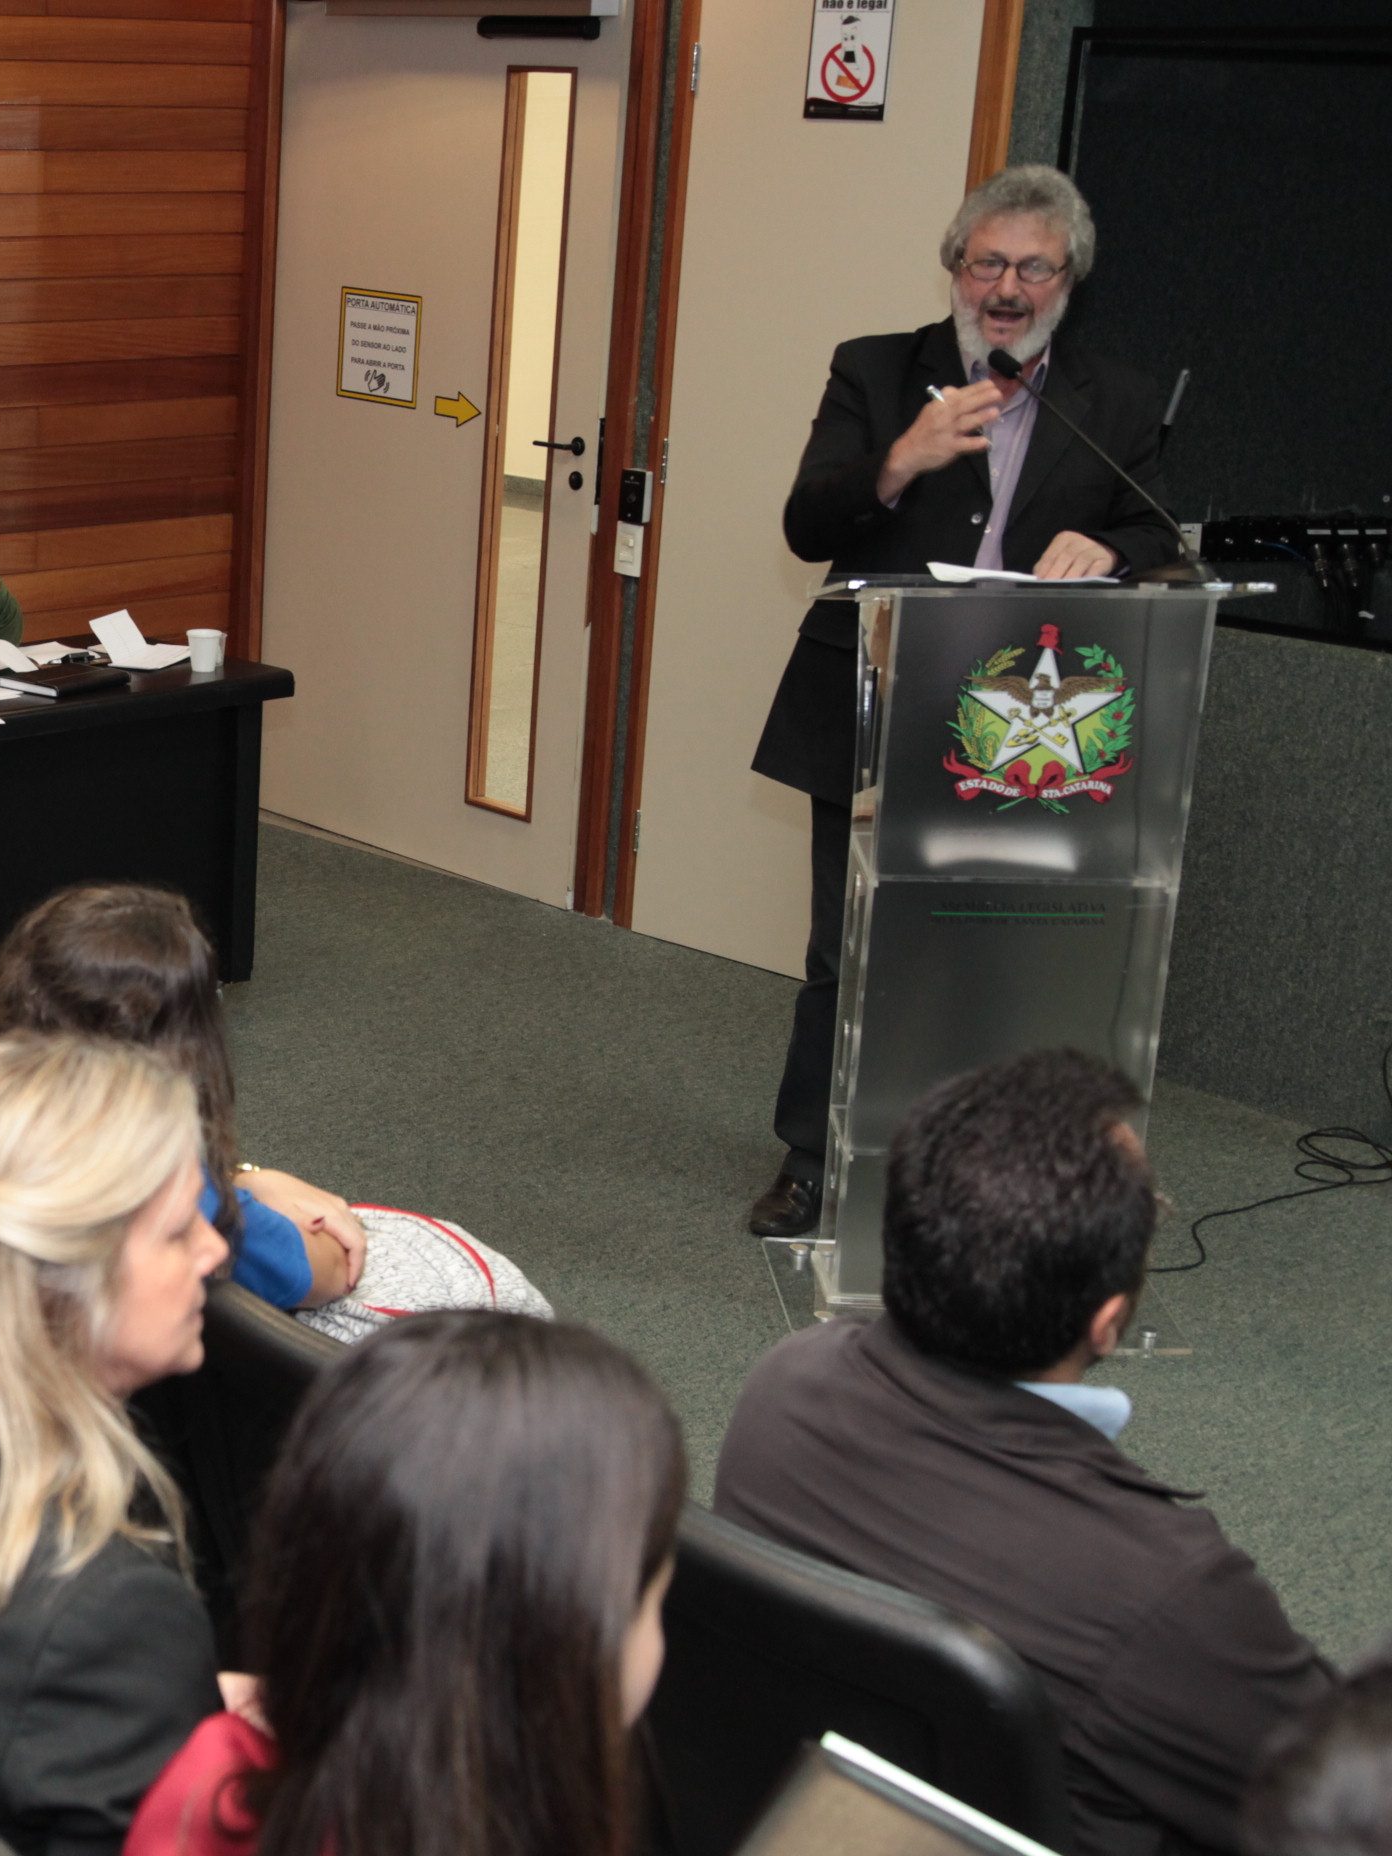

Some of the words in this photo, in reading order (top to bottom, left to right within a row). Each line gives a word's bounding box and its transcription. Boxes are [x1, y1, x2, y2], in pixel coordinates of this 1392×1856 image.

[346, 297, 369, 307] PORTA
[370, 300, 416, 314] AUTOMÁTICA
[350, 321, 367, 329] PASSE
[360, 340, 382, 349] SENSOR
[383, 343, 390, 351] AO
[391, 345, 407, 353] LADO
[351, 357, 364, 365] PARA
[388, 362, 405, 371] PORTA
[958, 779, 1006, 793] ESTADO
[1004, 786, 1021, 798] DE
